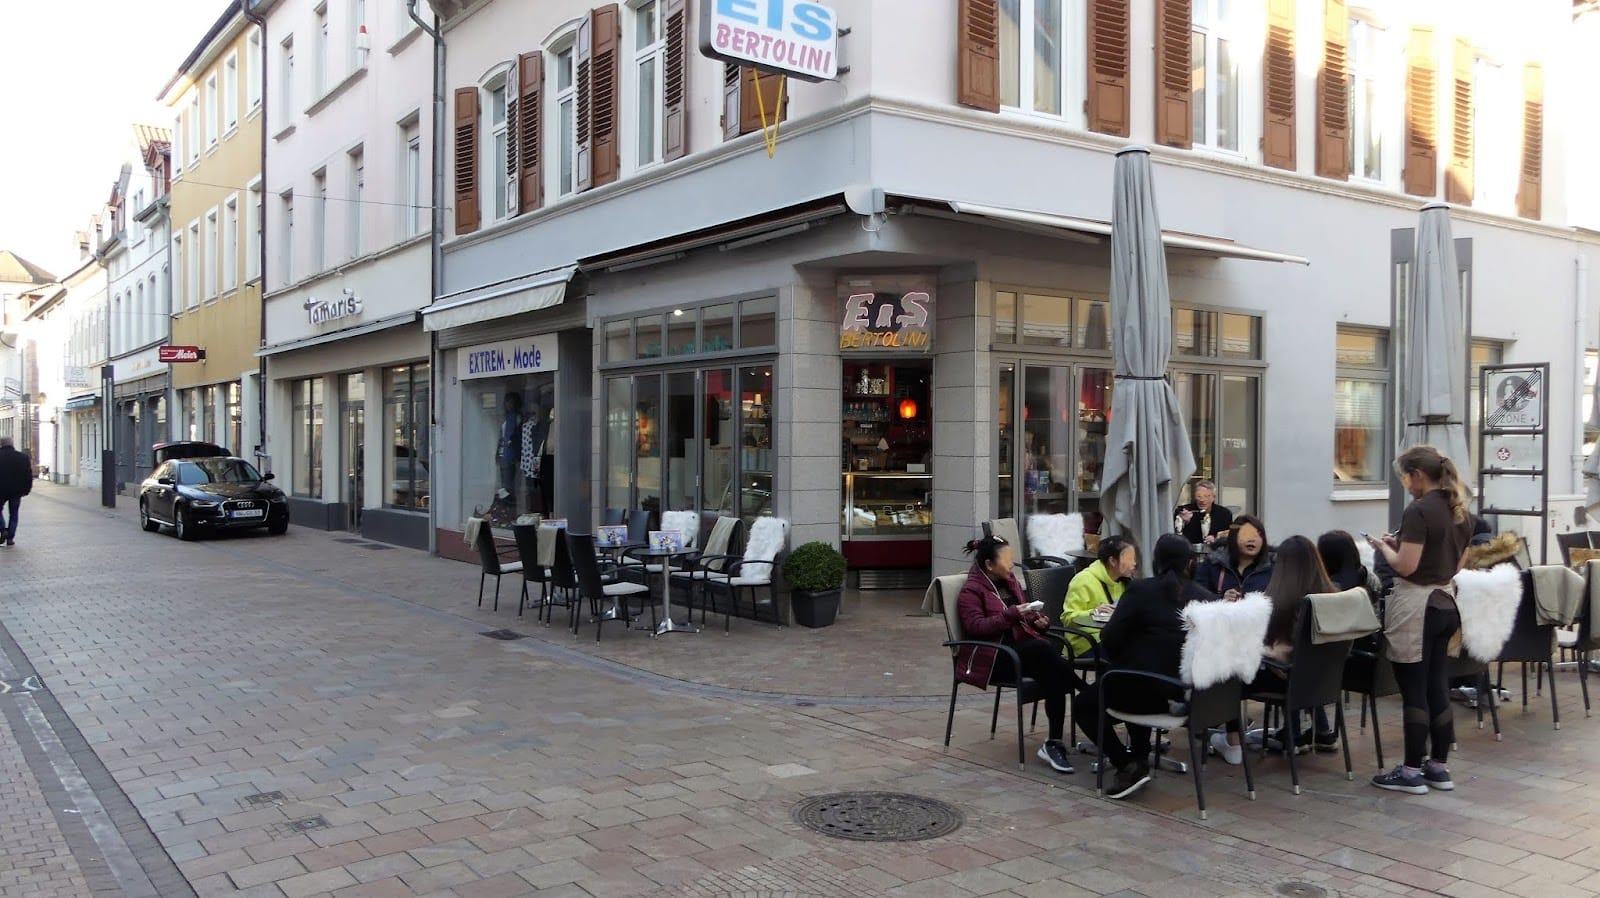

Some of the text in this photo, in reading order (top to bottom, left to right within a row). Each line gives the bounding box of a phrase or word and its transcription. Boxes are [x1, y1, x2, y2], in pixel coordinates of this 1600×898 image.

[716, 24, 831, 74] BERTOLINI
[304, 288, 362, 324] Tamaris
[840, 331, 928, 348] BERTOLINI
[469, 344, 541, 374] EXTREM Mode
[1500, 414, 1527, 424] ZONE
